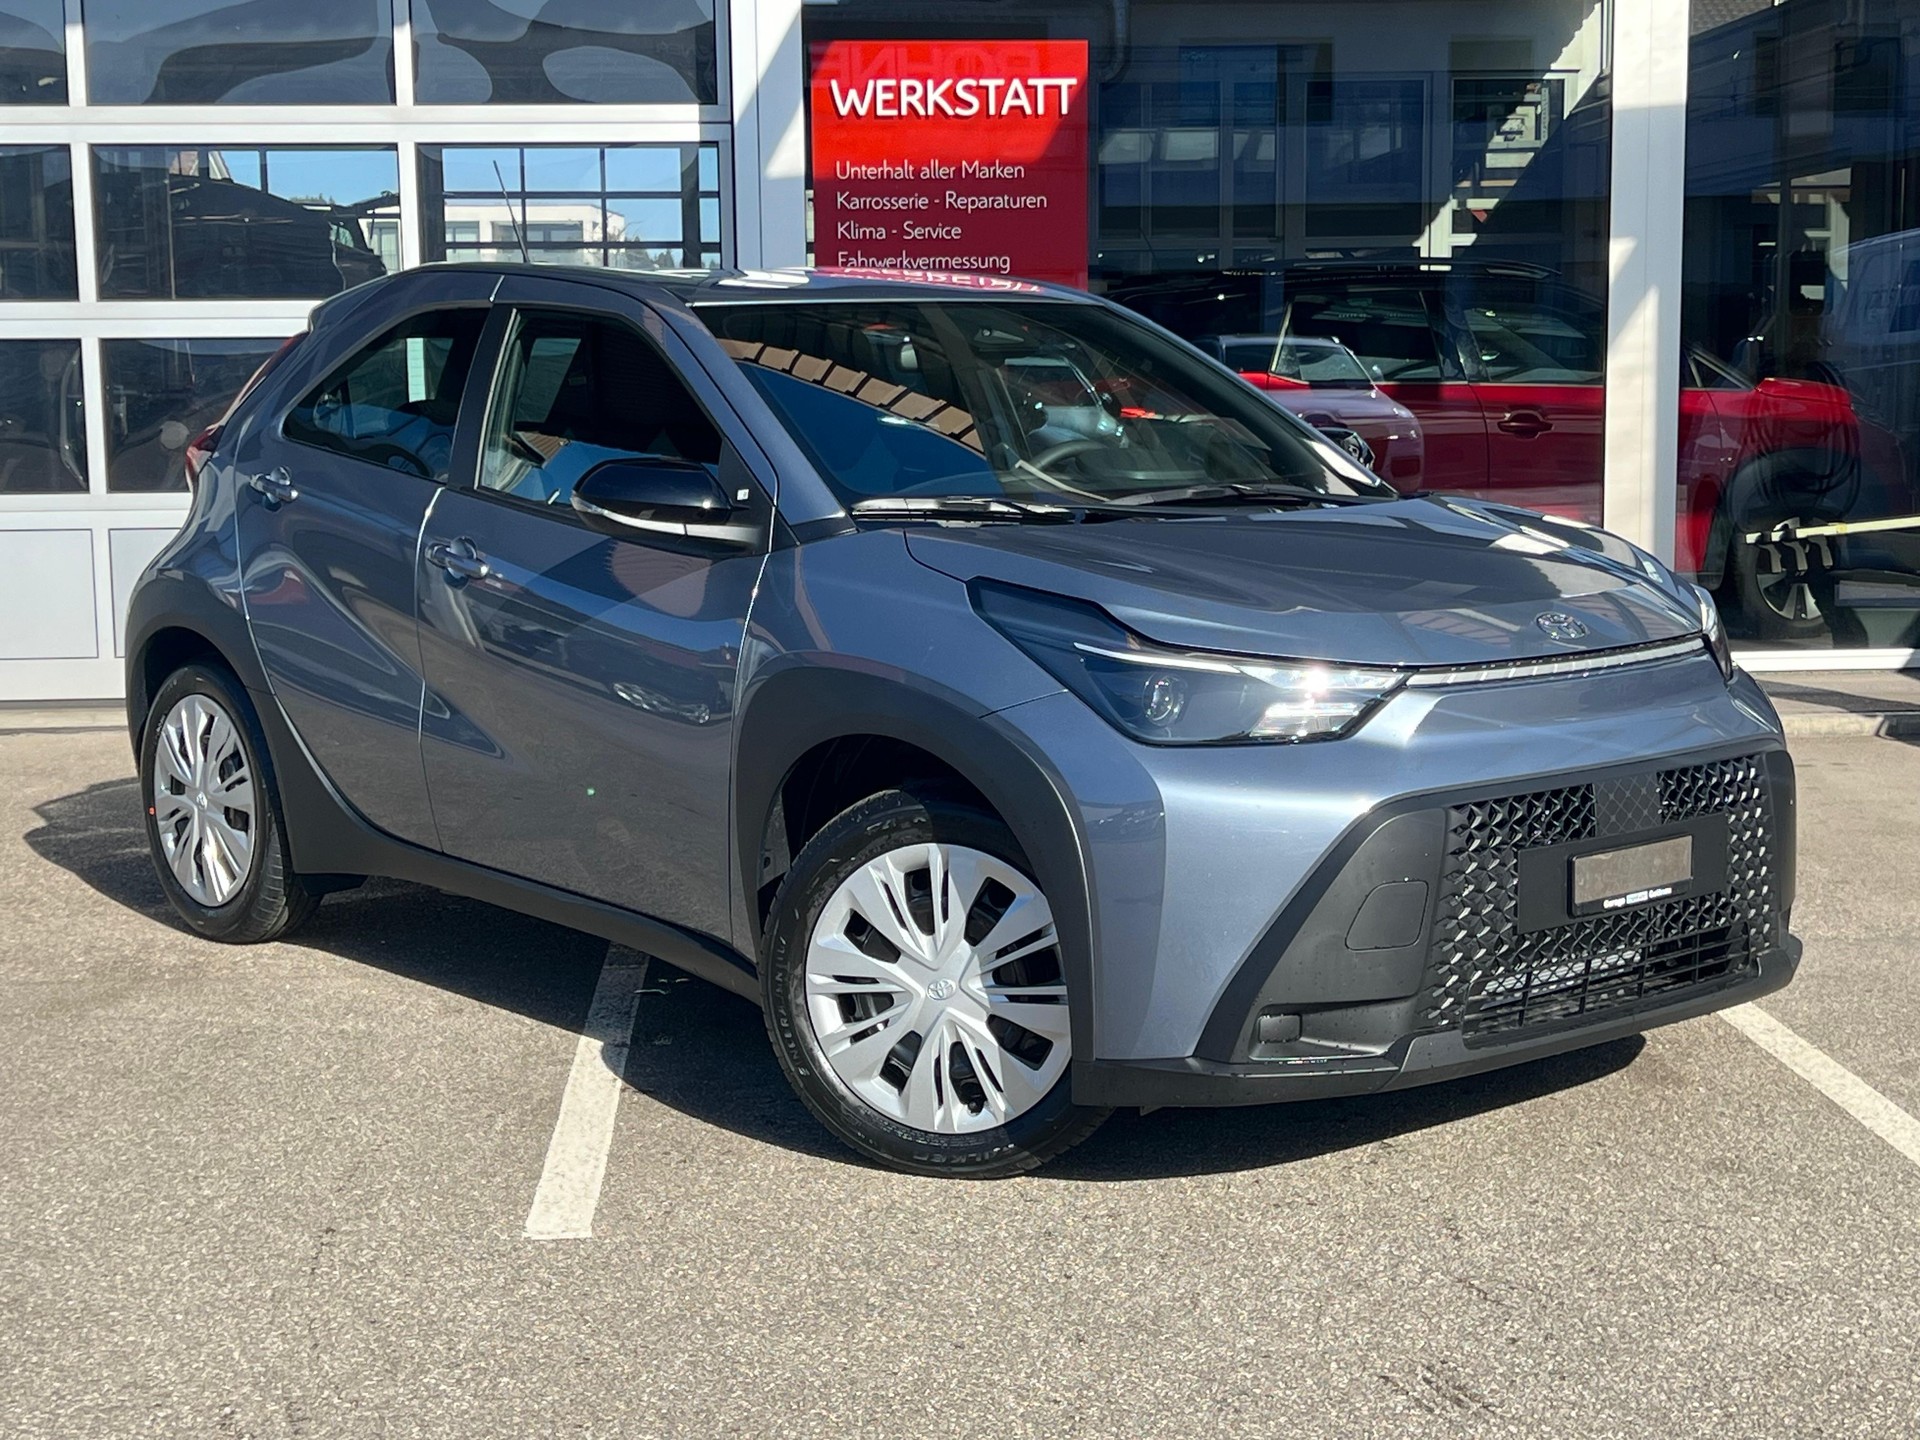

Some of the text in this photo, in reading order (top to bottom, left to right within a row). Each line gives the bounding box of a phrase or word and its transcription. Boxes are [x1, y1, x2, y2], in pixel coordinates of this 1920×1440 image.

[830, 77, 1078, 117] WERKSTATT
[836, 160, 1025, 181] Unterhalt aller Marken
[836, 191, 929, 211] Karrosserie
[945, 190, 1048, 214] Reparaturen
[837, 221, 886, 240] Klima
[902, 221, 962, 240] Service
[837, 250, 1011, 274] Fahrwerkvermessung
